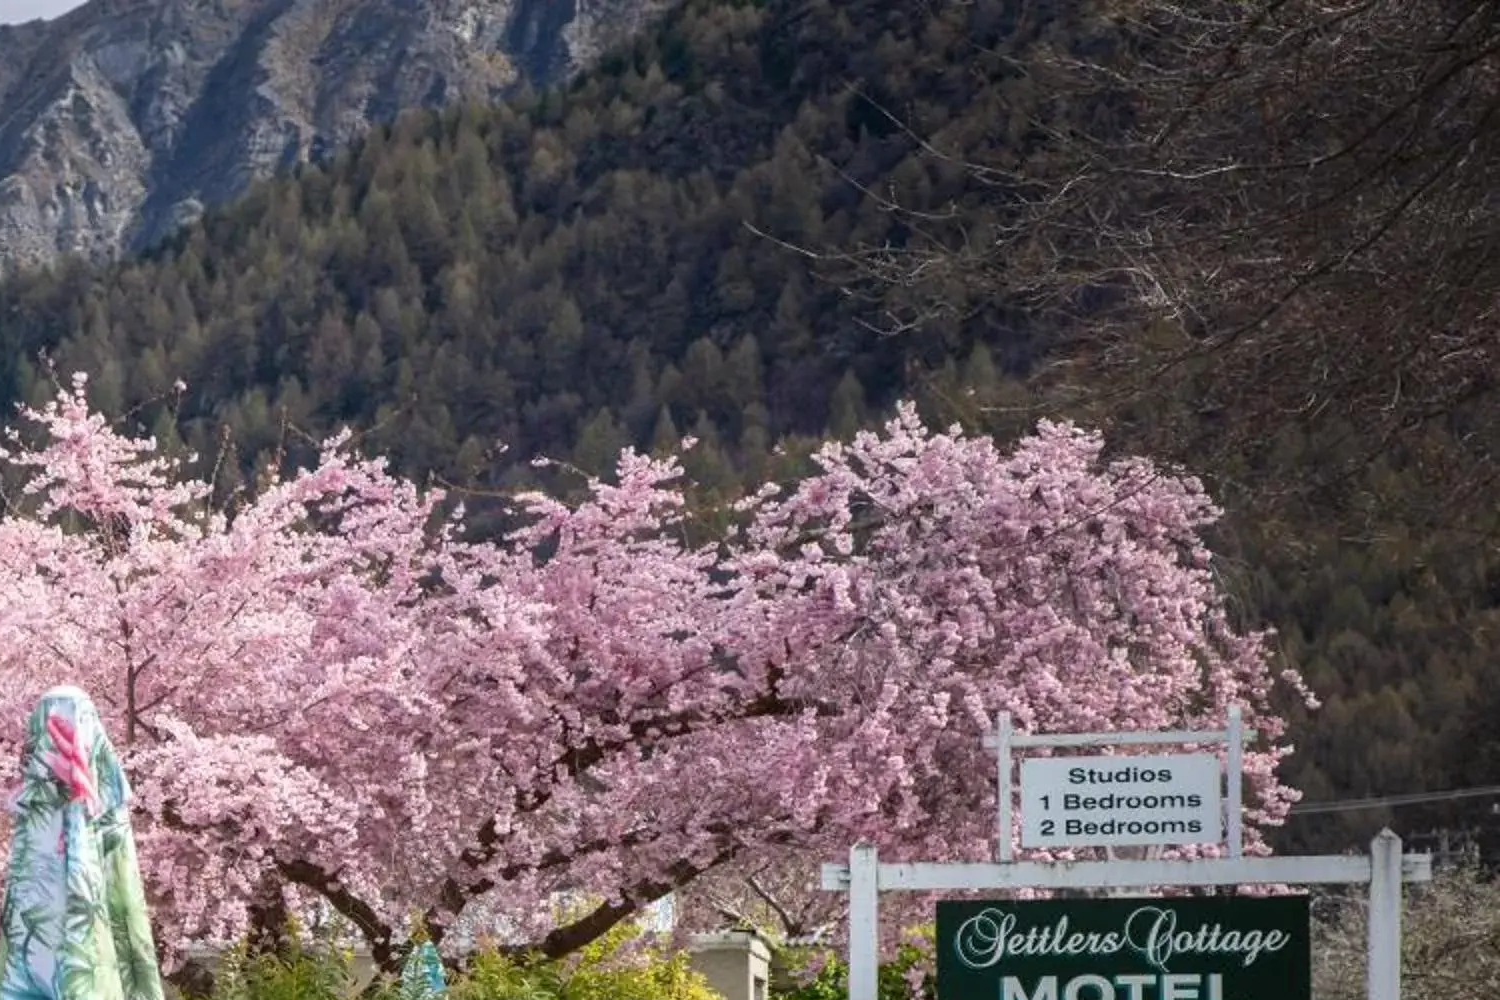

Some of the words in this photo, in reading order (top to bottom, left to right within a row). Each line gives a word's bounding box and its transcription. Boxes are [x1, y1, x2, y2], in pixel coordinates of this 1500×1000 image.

[1068, 767, 1173, 784] Studios
[1039, 796, 1050, 811] 1
[1063, 793, 1202, 811] Bedrooms
[1040, 820, 1055, 837] 2
[1065, 818, 1203, 836] Bedrooms
[955, 907, 1126, 969] Settlers
[1125, 906, 1291, 973] Cottage
